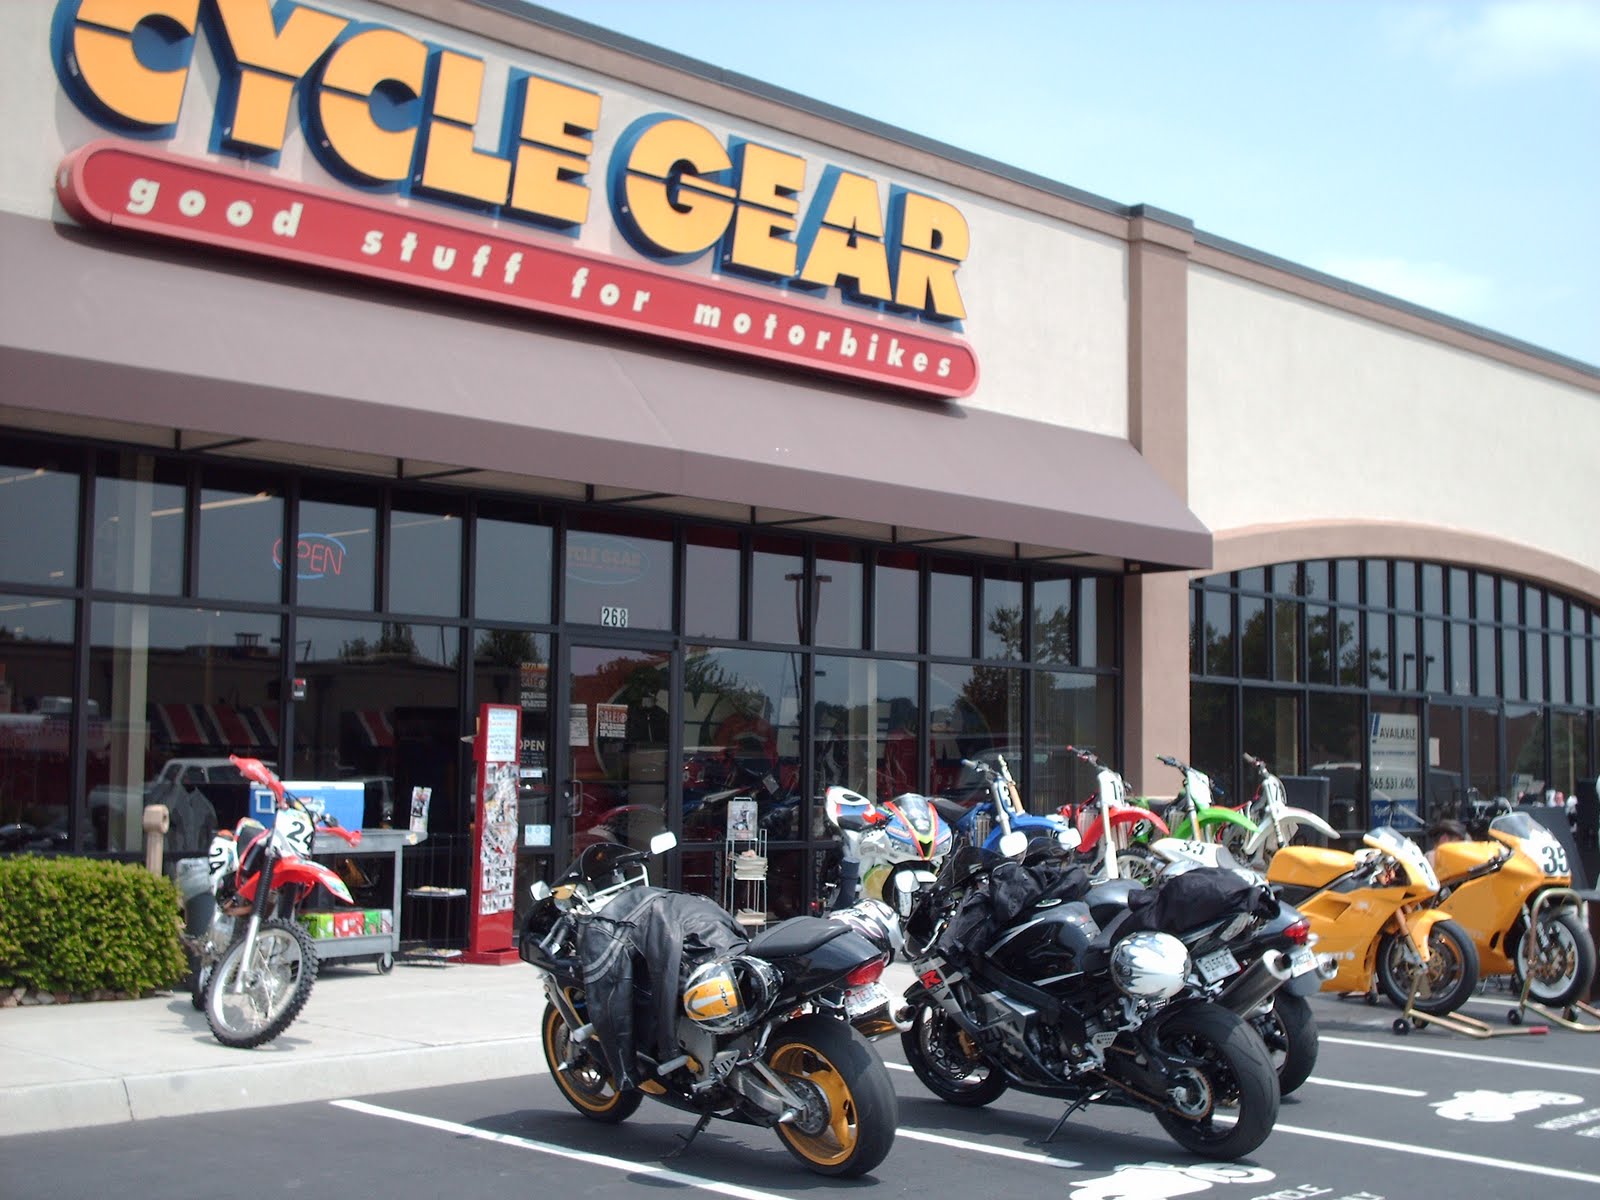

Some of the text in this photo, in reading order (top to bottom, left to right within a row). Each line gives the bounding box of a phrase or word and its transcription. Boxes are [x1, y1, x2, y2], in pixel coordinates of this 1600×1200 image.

[55, 0, 969, 330] CYCLE GEAR
[127, 176, 953, 379] good stuff for motorbikes
[602, 607, 628, 628] 268
[1379, 727, 1416, 740] AVAILABLE
[1541, 844, 1571, 875] 35
